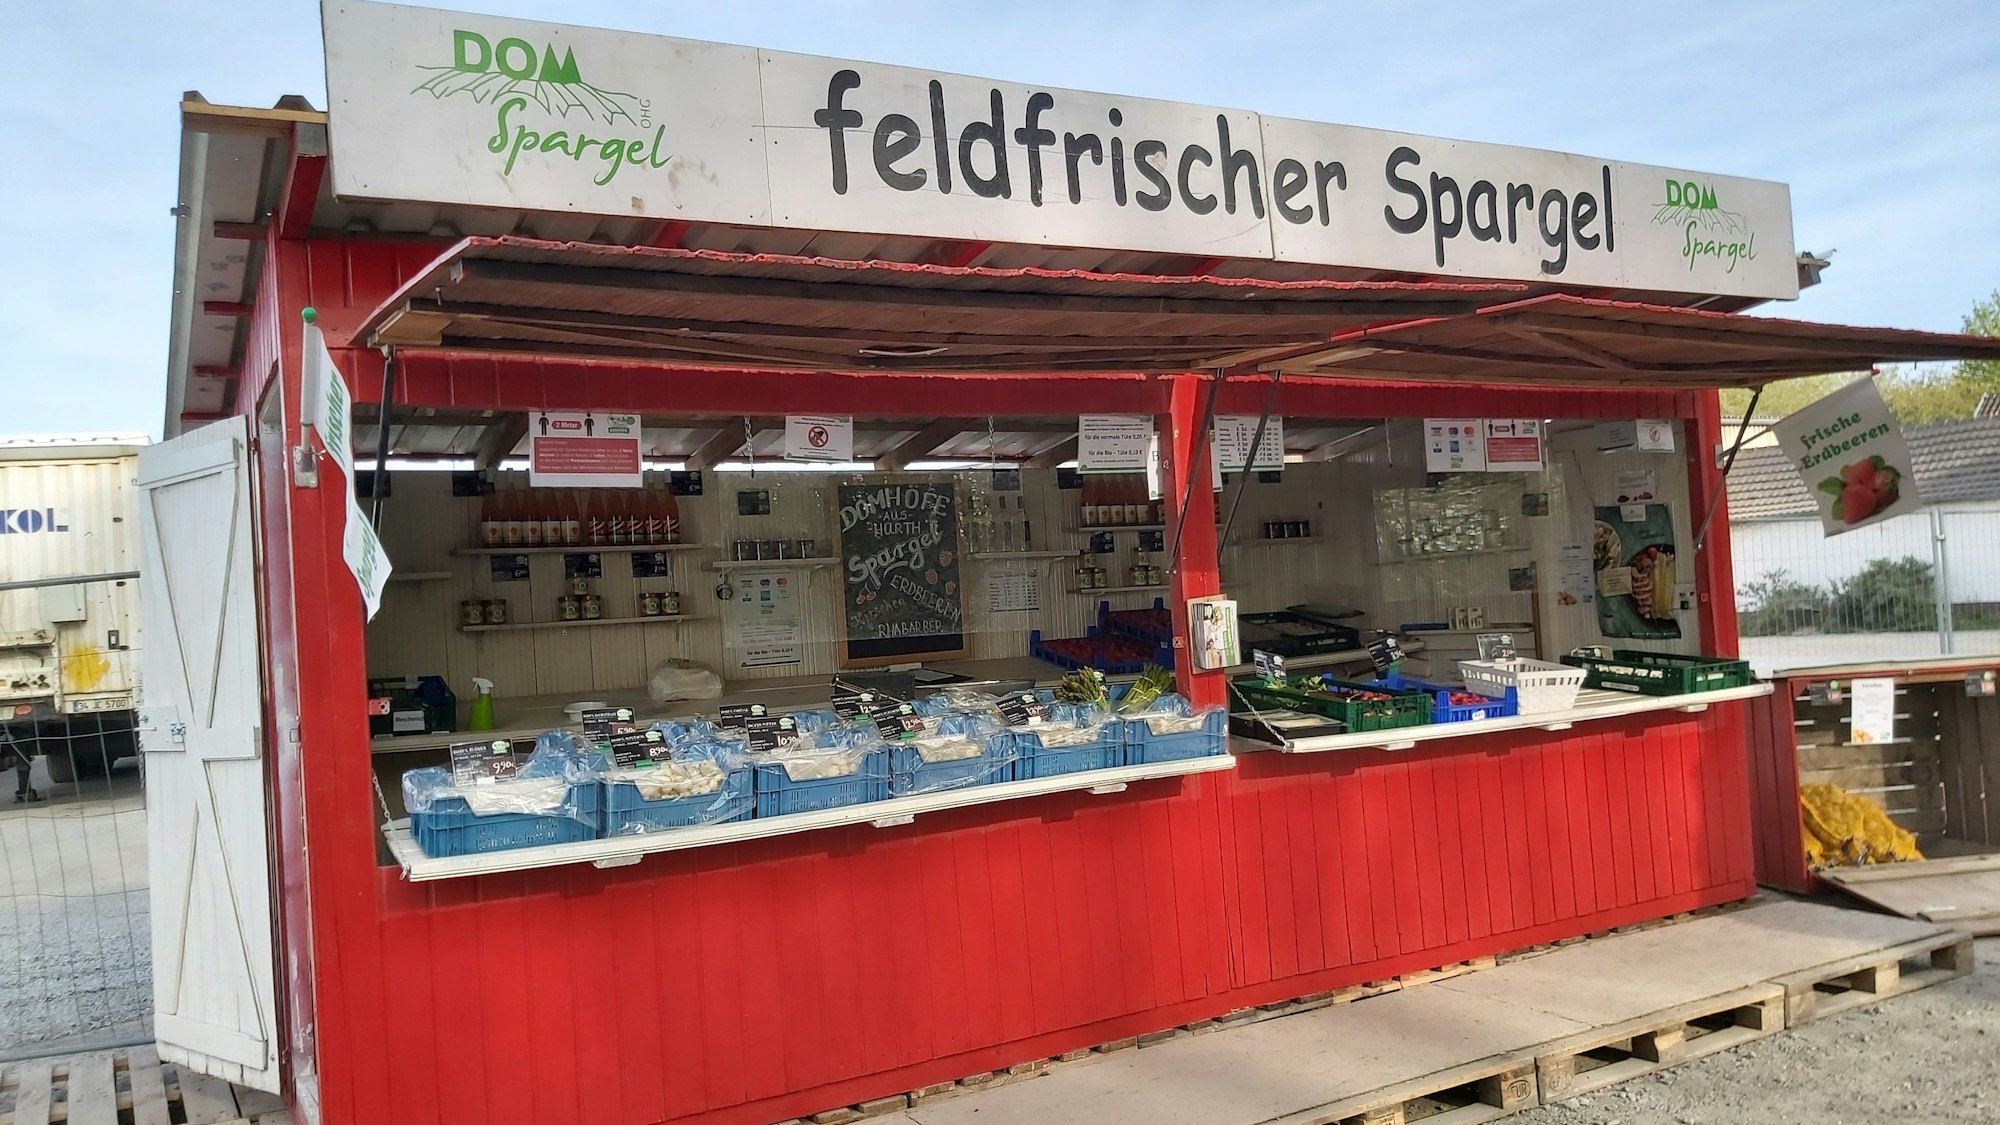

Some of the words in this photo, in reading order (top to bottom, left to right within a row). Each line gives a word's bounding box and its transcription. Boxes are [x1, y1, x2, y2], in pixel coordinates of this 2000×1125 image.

[453, 29, 582, 84] DOM
[639, 98, 652, 129] OHG
[487, 97, 674, 187] Spargel
[814, 69, 1347, 227] feldfrischer
[1384, 146, 1614, 275] Spargel
[1666, 179, 1718, 209] DOM
[1682, 220, 1758, 273] Spargel
[1800, 412, 1862, 451] frische
[1800, 422, 1891, 471] Erdbeeren
[889, 574, 962, 623] ERDBEEREN
[877, 619, 943, 638] RHABARBER
[105, 699, 126, 708] 5700
